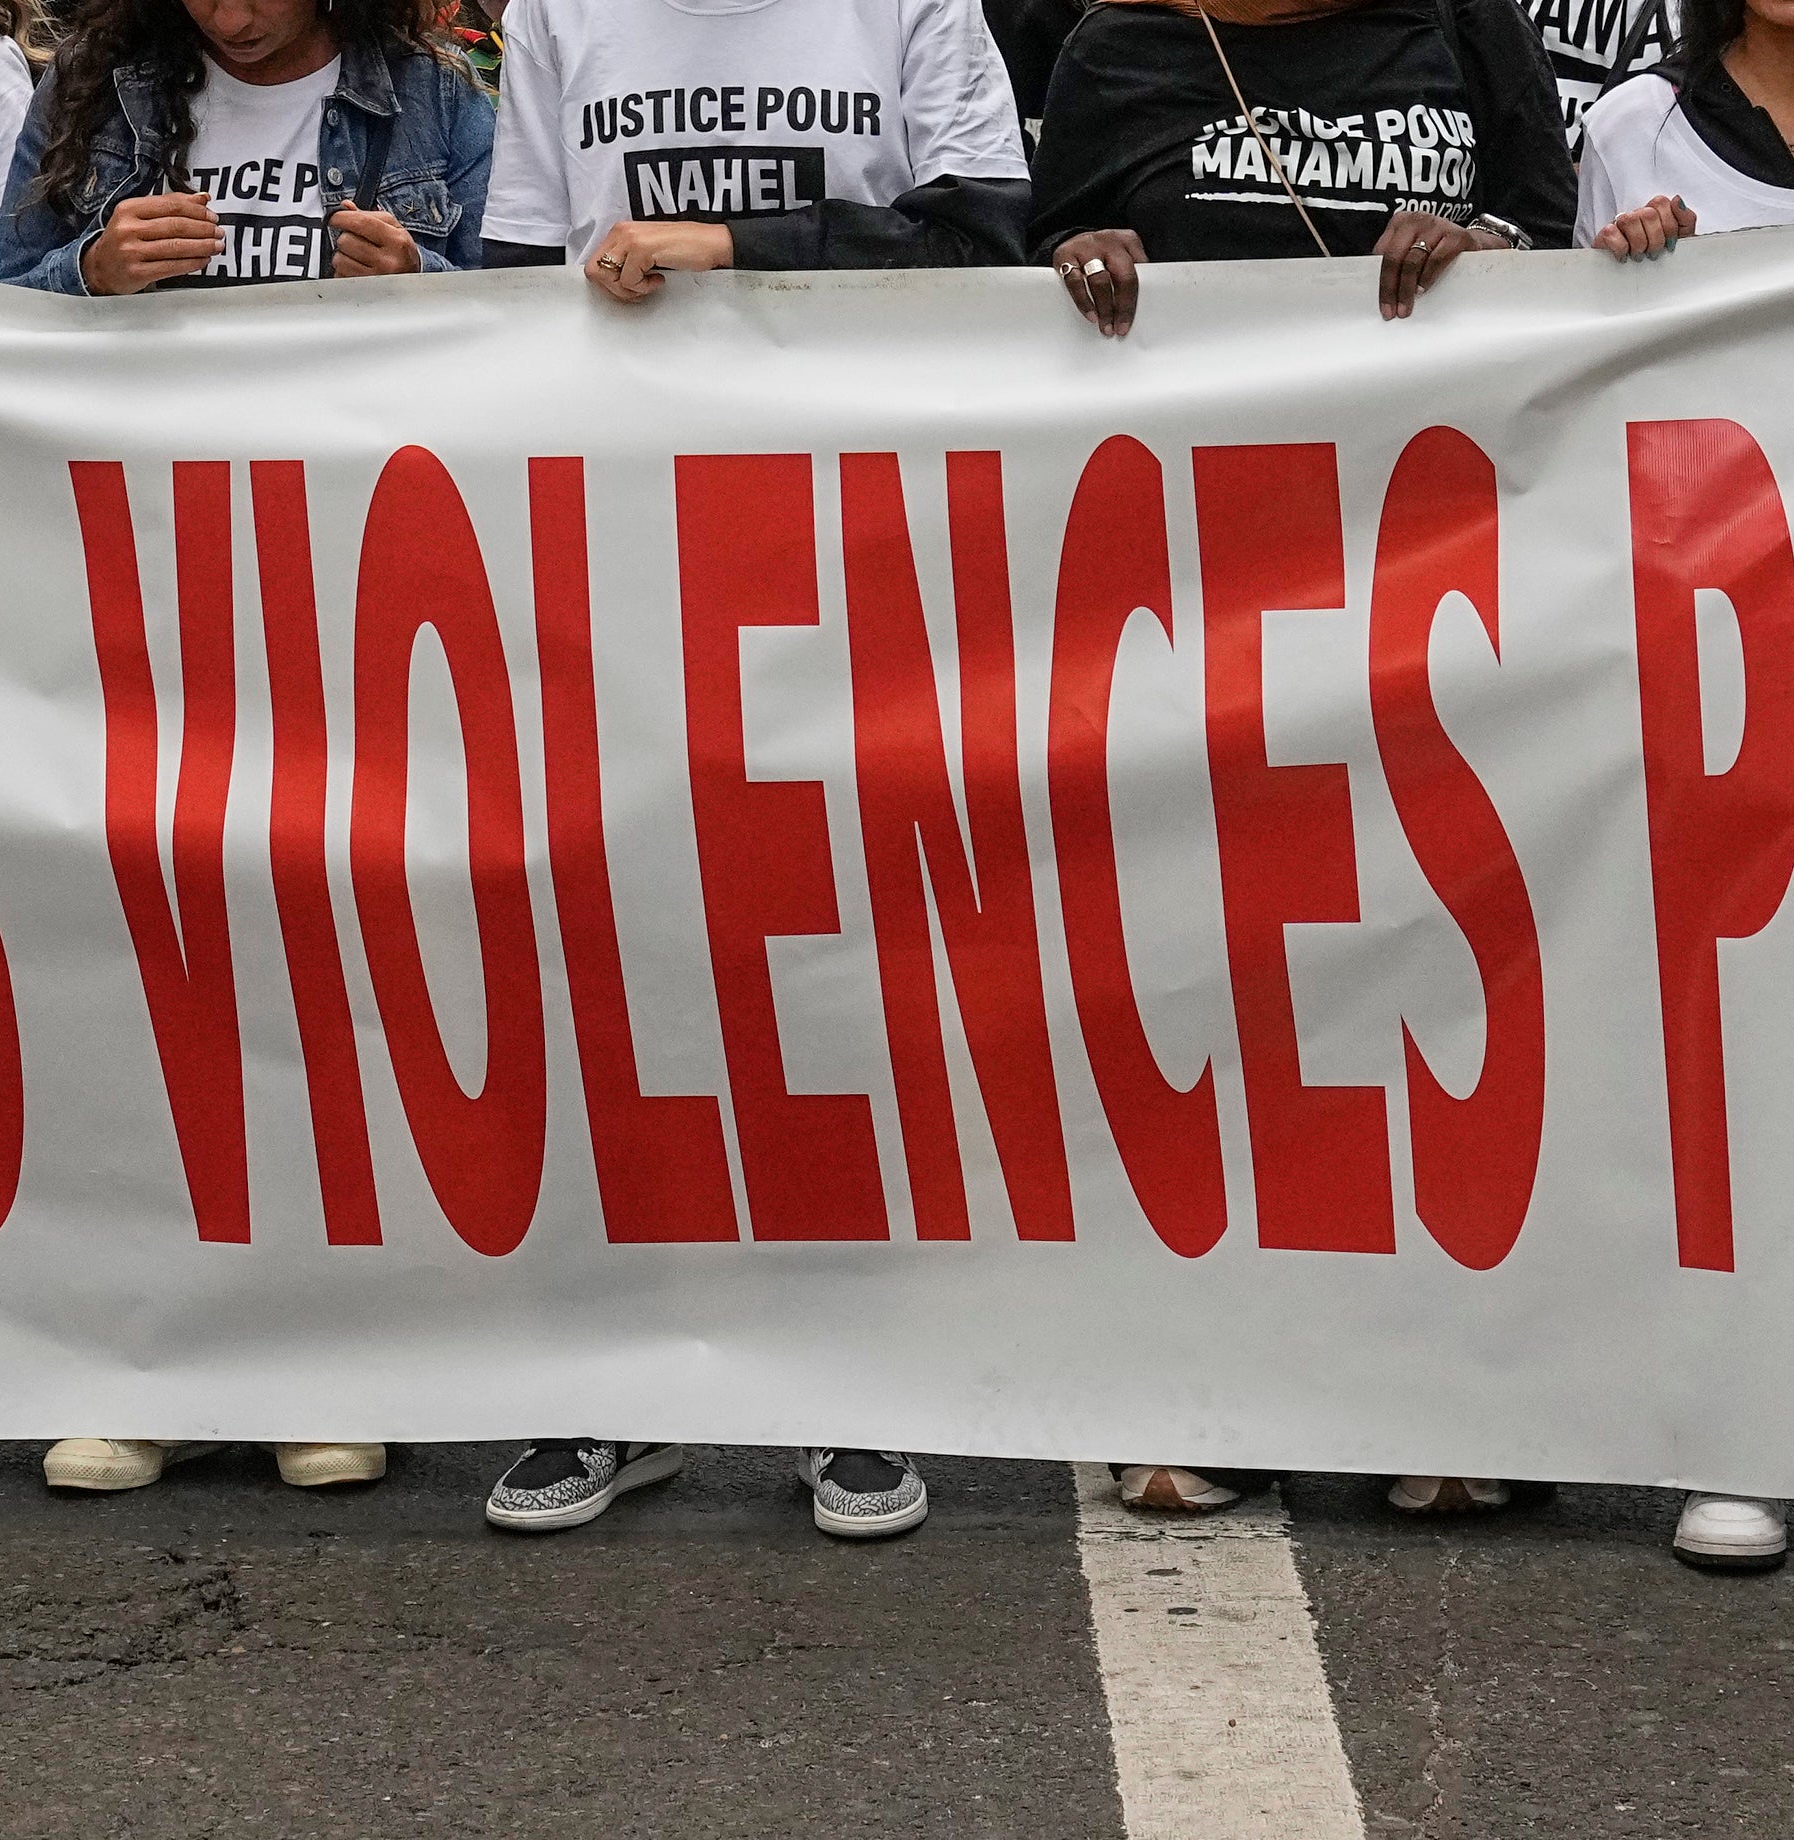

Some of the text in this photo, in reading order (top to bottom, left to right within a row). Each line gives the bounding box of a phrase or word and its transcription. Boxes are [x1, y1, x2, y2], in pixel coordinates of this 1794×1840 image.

[580, 86, 882, 150] JUSTICE POUR
[1375, 104, 1477, 149] POUR
[636, 158, 814, 217] NAHEL
[1191, 136, 1477, 201] MAHAMADOU
[67, 426, 1546, 1272] VIOLENCES
